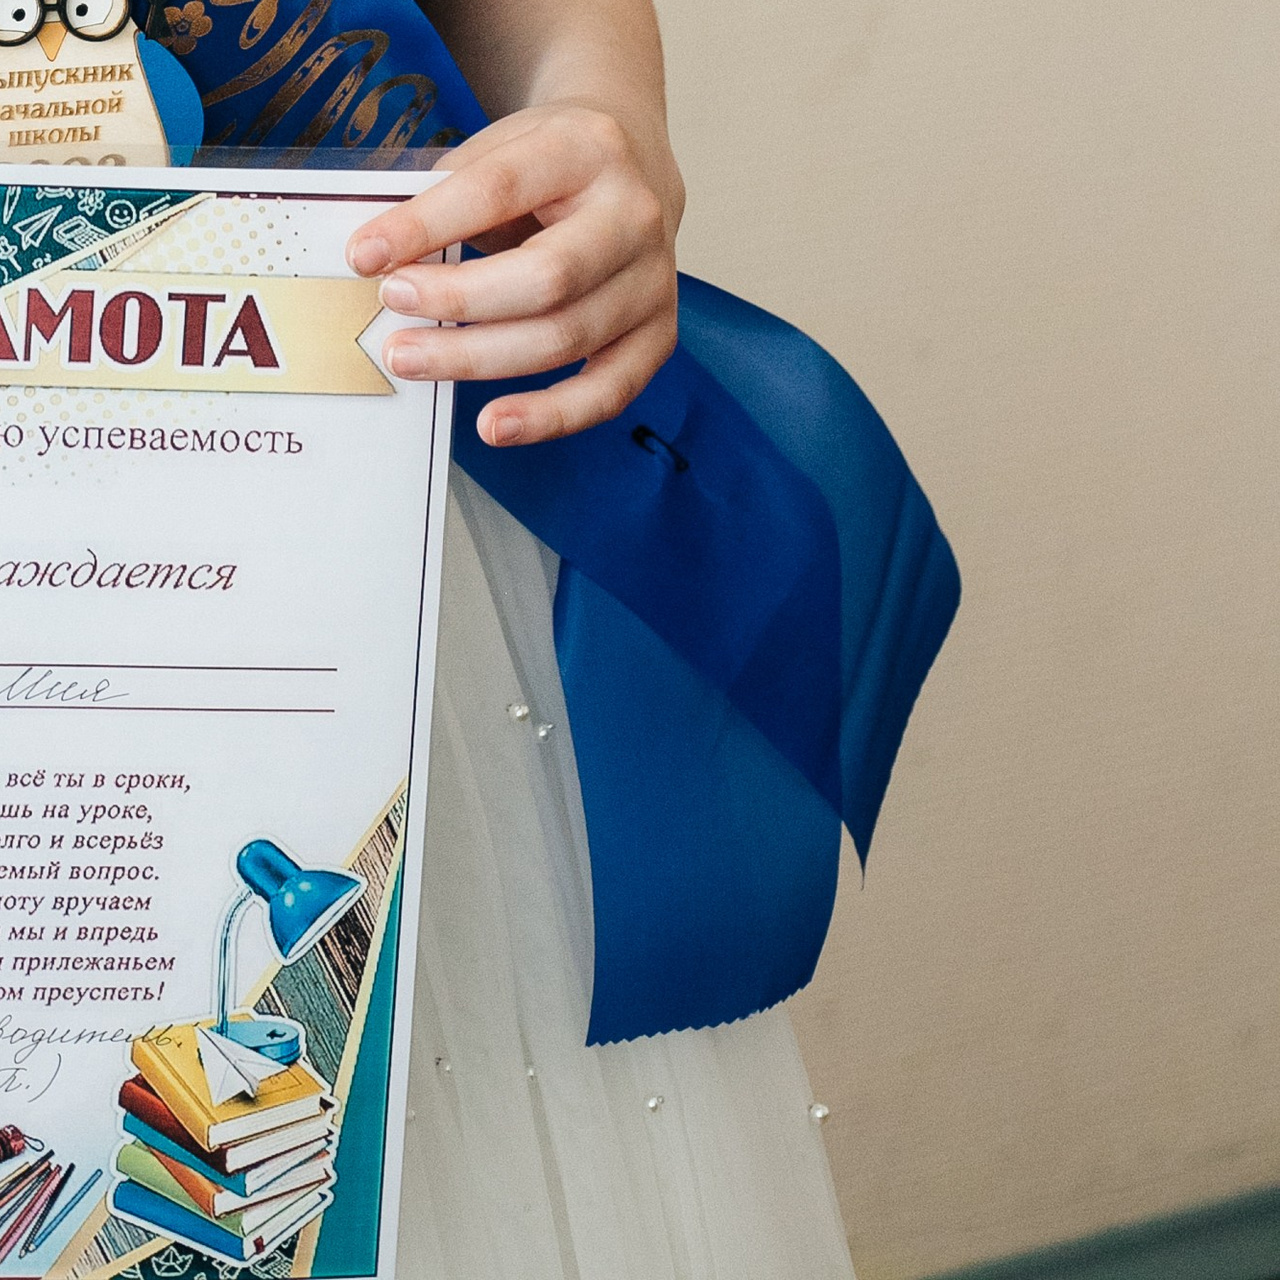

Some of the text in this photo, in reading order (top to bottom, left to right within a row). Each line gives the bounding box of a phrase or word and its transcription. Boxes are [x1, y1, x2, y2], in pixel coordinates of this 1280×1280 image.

[8, 125, 101, 147] школы
[37, 421, 304, 456] успеваемость
[4, 769, 47, 788] всё
[53, 772, 86, 789] ты
[91, 773, 106, 789] в
[113, 773, 191, 795] сроки,
[41, 803, 70, 820] на
[75, 804, 153, 825] уроке,
[48, 834, 65, 850] и
[71, 830, 164, 856] всерьёз
[68, 865, 160, 886] вопрос.
[50, 895, 153, 917] вручаем
[7, 925, 46, 941] мы
[52, 926, 69, 942] и
[75, 925, 159, 947] впредь
[11, 956, 176, 977] прилежаньем
[31, 980, 166, 1007] преуспеть!
